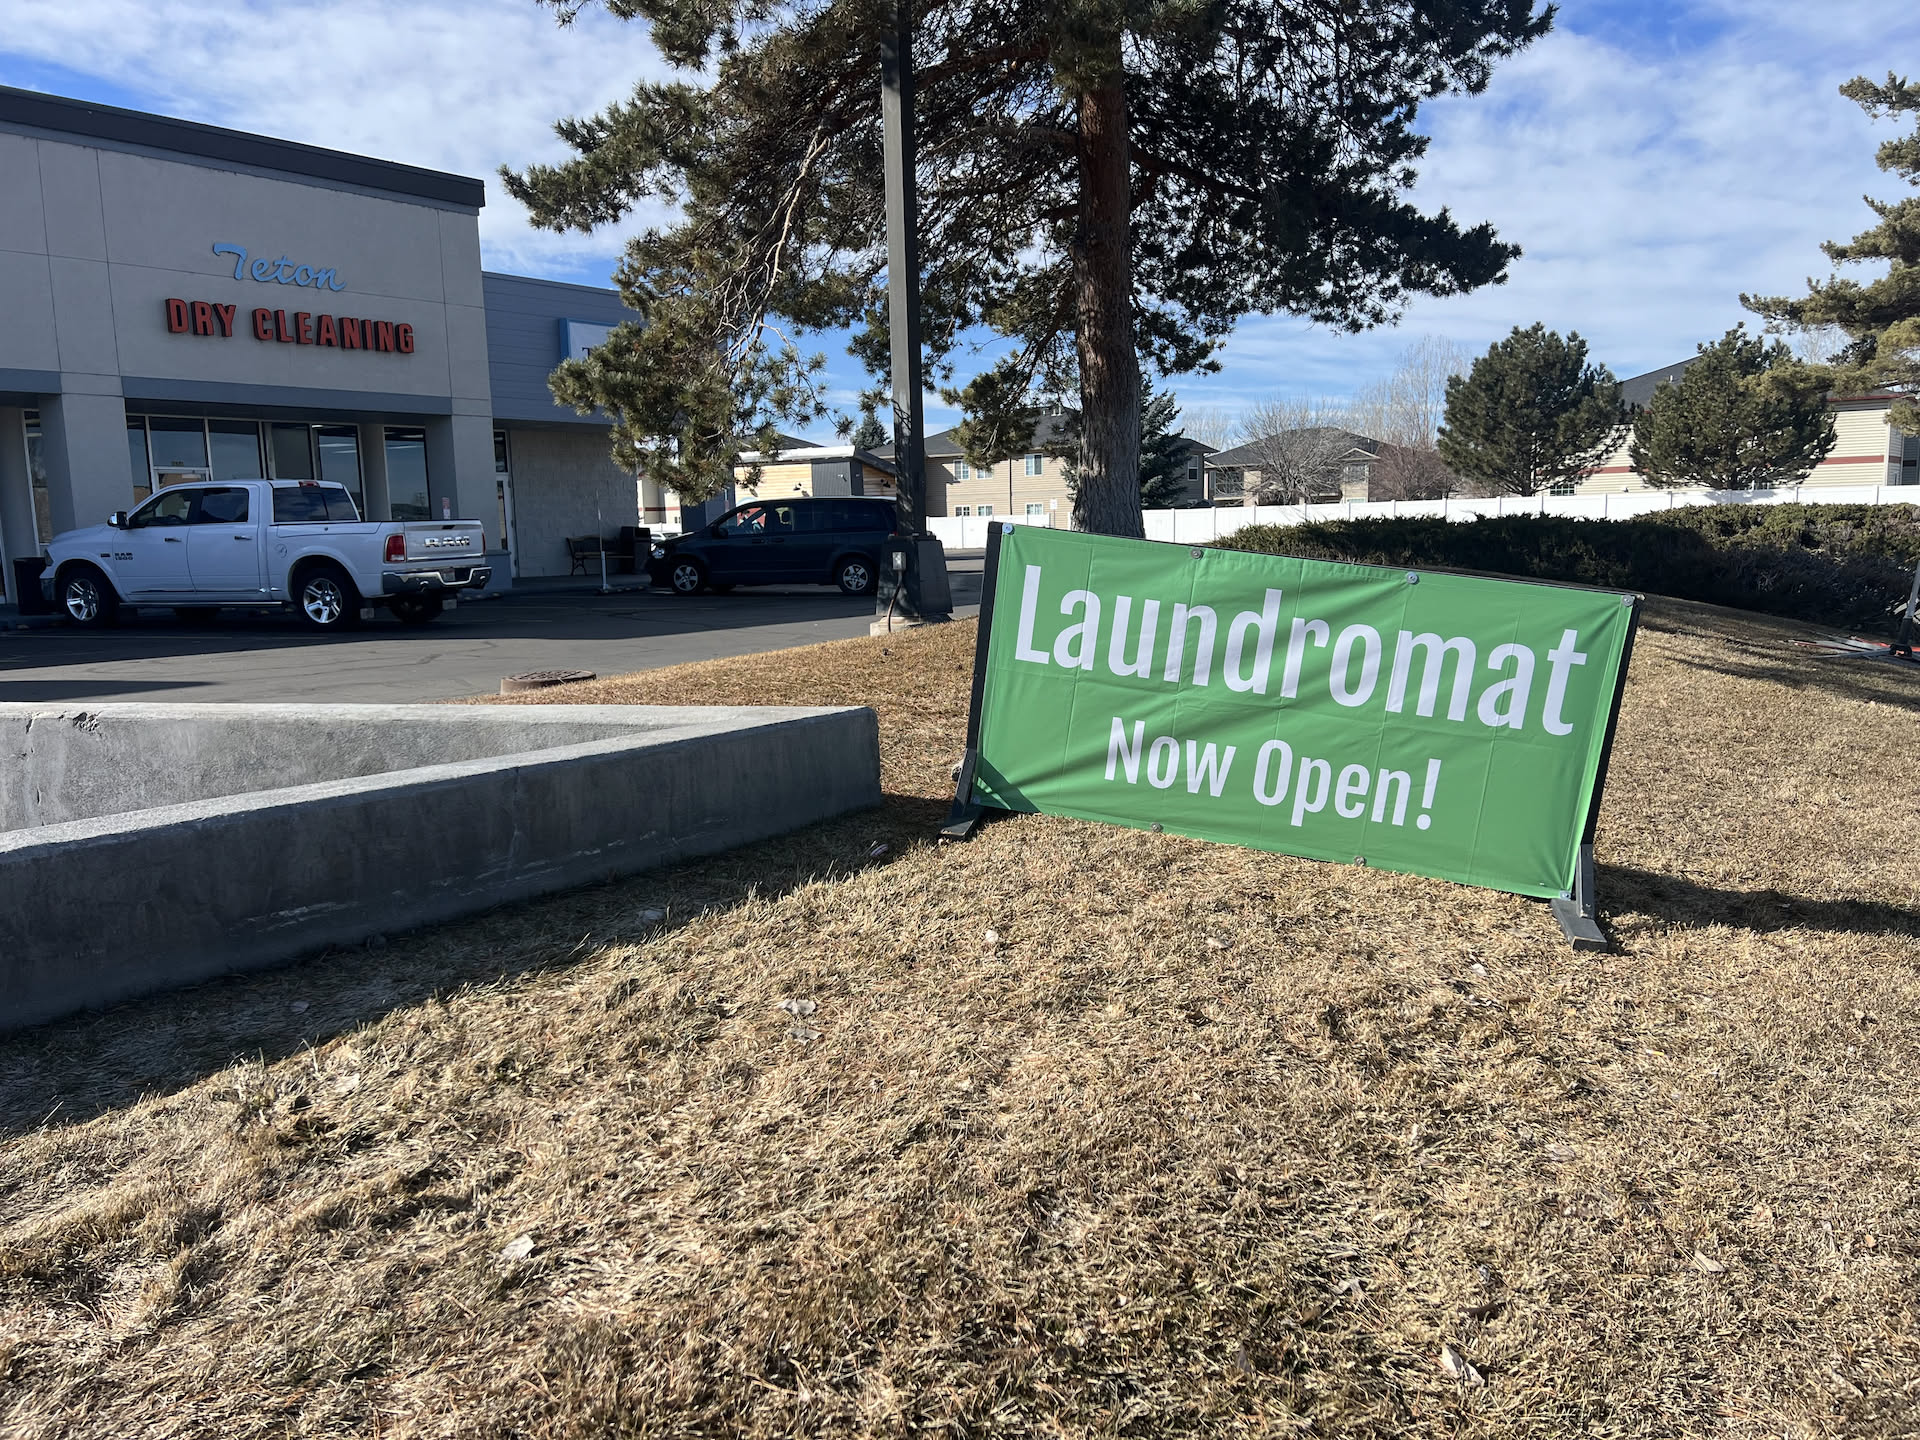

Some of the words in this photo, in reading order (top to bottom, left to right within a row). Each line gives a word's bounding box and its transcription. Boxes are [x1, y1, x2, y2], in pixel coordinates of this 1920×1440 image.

[213, 243, 347, 291] Teton
[165, 298, 236, 337] DRY
[253, 308, 414, 353] CLEANING
[424, 536, 470, 548] RAM
[1015, 565, 1587, 736] Laundromat
[1104, 717, 1237, 797] Now
[1252, 739, 1442, 830] Open!
